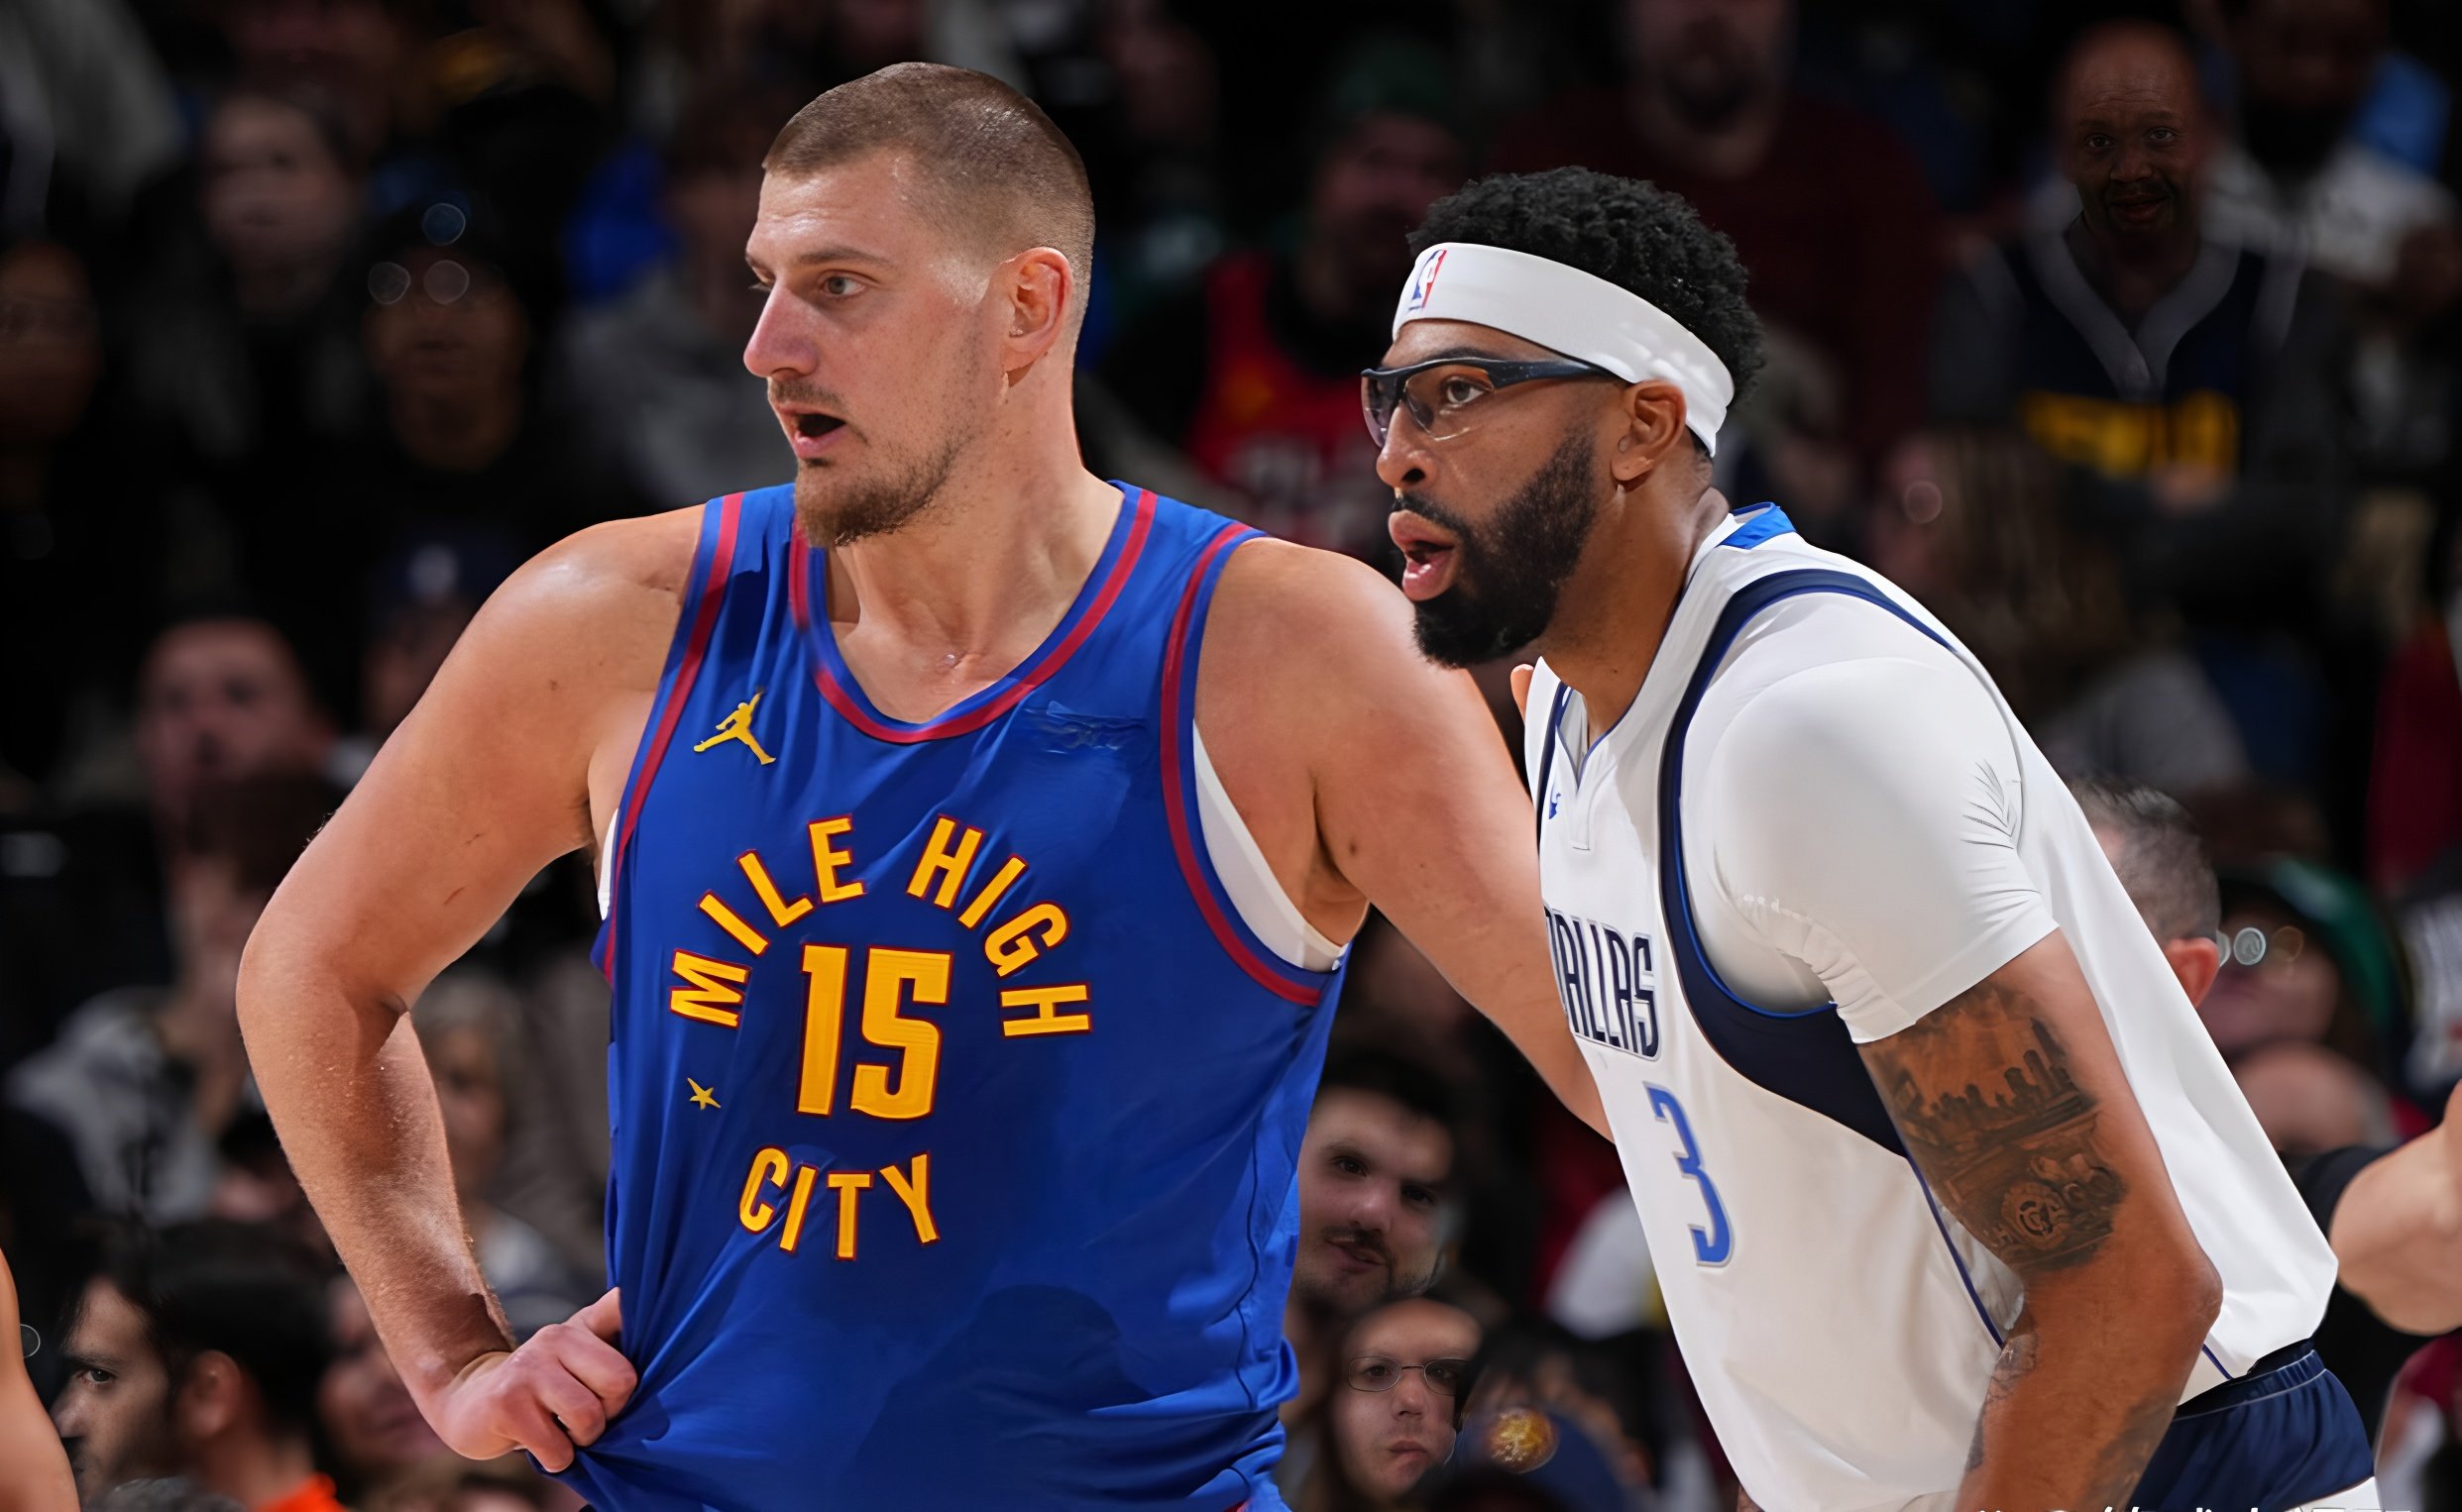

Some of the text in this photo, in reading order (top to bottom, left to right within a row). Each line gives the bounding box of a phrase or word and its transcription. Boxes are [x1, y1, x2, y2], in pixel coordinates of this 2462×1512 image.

[668, 812, 1092, 1038] MILE HIGH
[795, 942, 954, 1122] 15
[737, 1144, 942, 1261] CITY
[1641, 1080, 1735, 1268] 3
